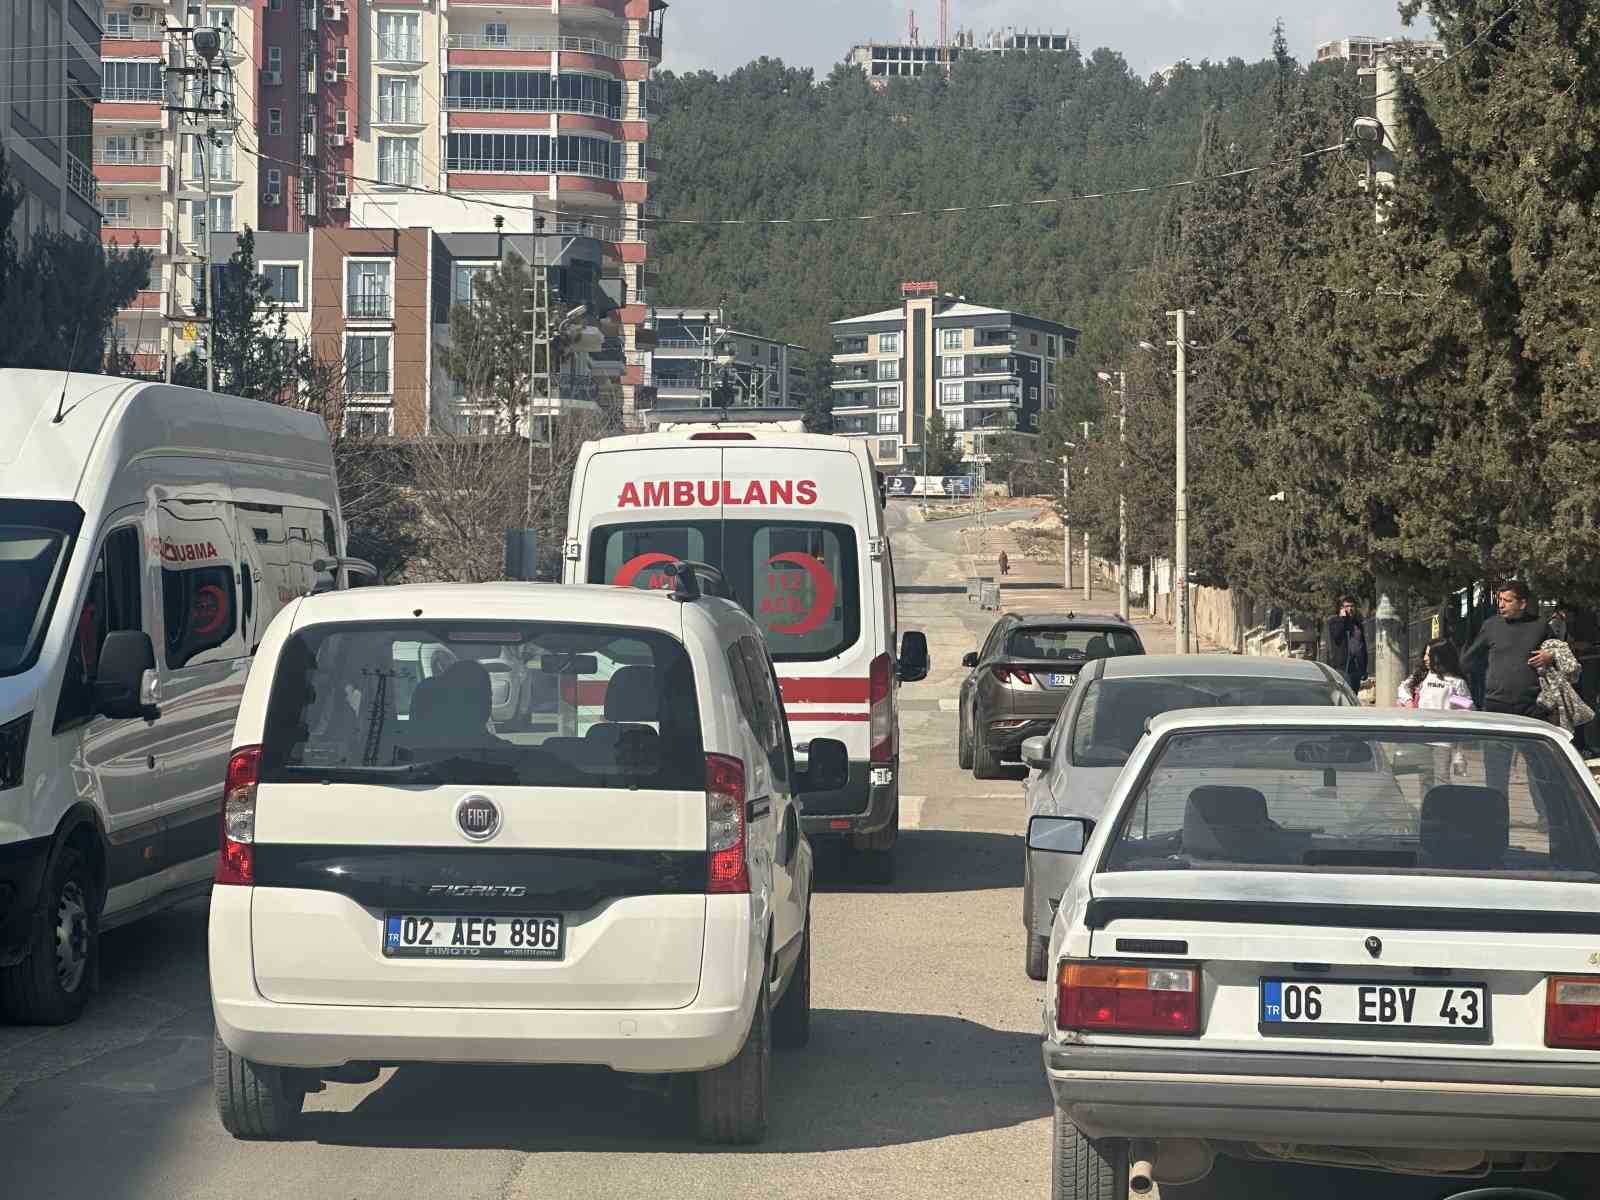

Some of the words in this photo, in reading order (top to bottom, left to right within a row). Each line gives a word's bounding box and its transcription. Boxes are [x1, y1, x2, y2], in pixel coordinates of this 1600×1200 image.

[617, 479, 818, 508] AMBULANS
[467, 808, 489, 826] FIAT
[388, 933, 400, 942] TR
[403, 916, 435, 946] 02
[451, 917, 497, 947] AEG
[510, 918, 557, 948] 896
[1266, 1005, 1280, 1017] TR
[1284, 984, 1323, 1021] 06
[1358, 986, 1417, 1024] EBV
[1439, 988, 1479, 1026] 43
